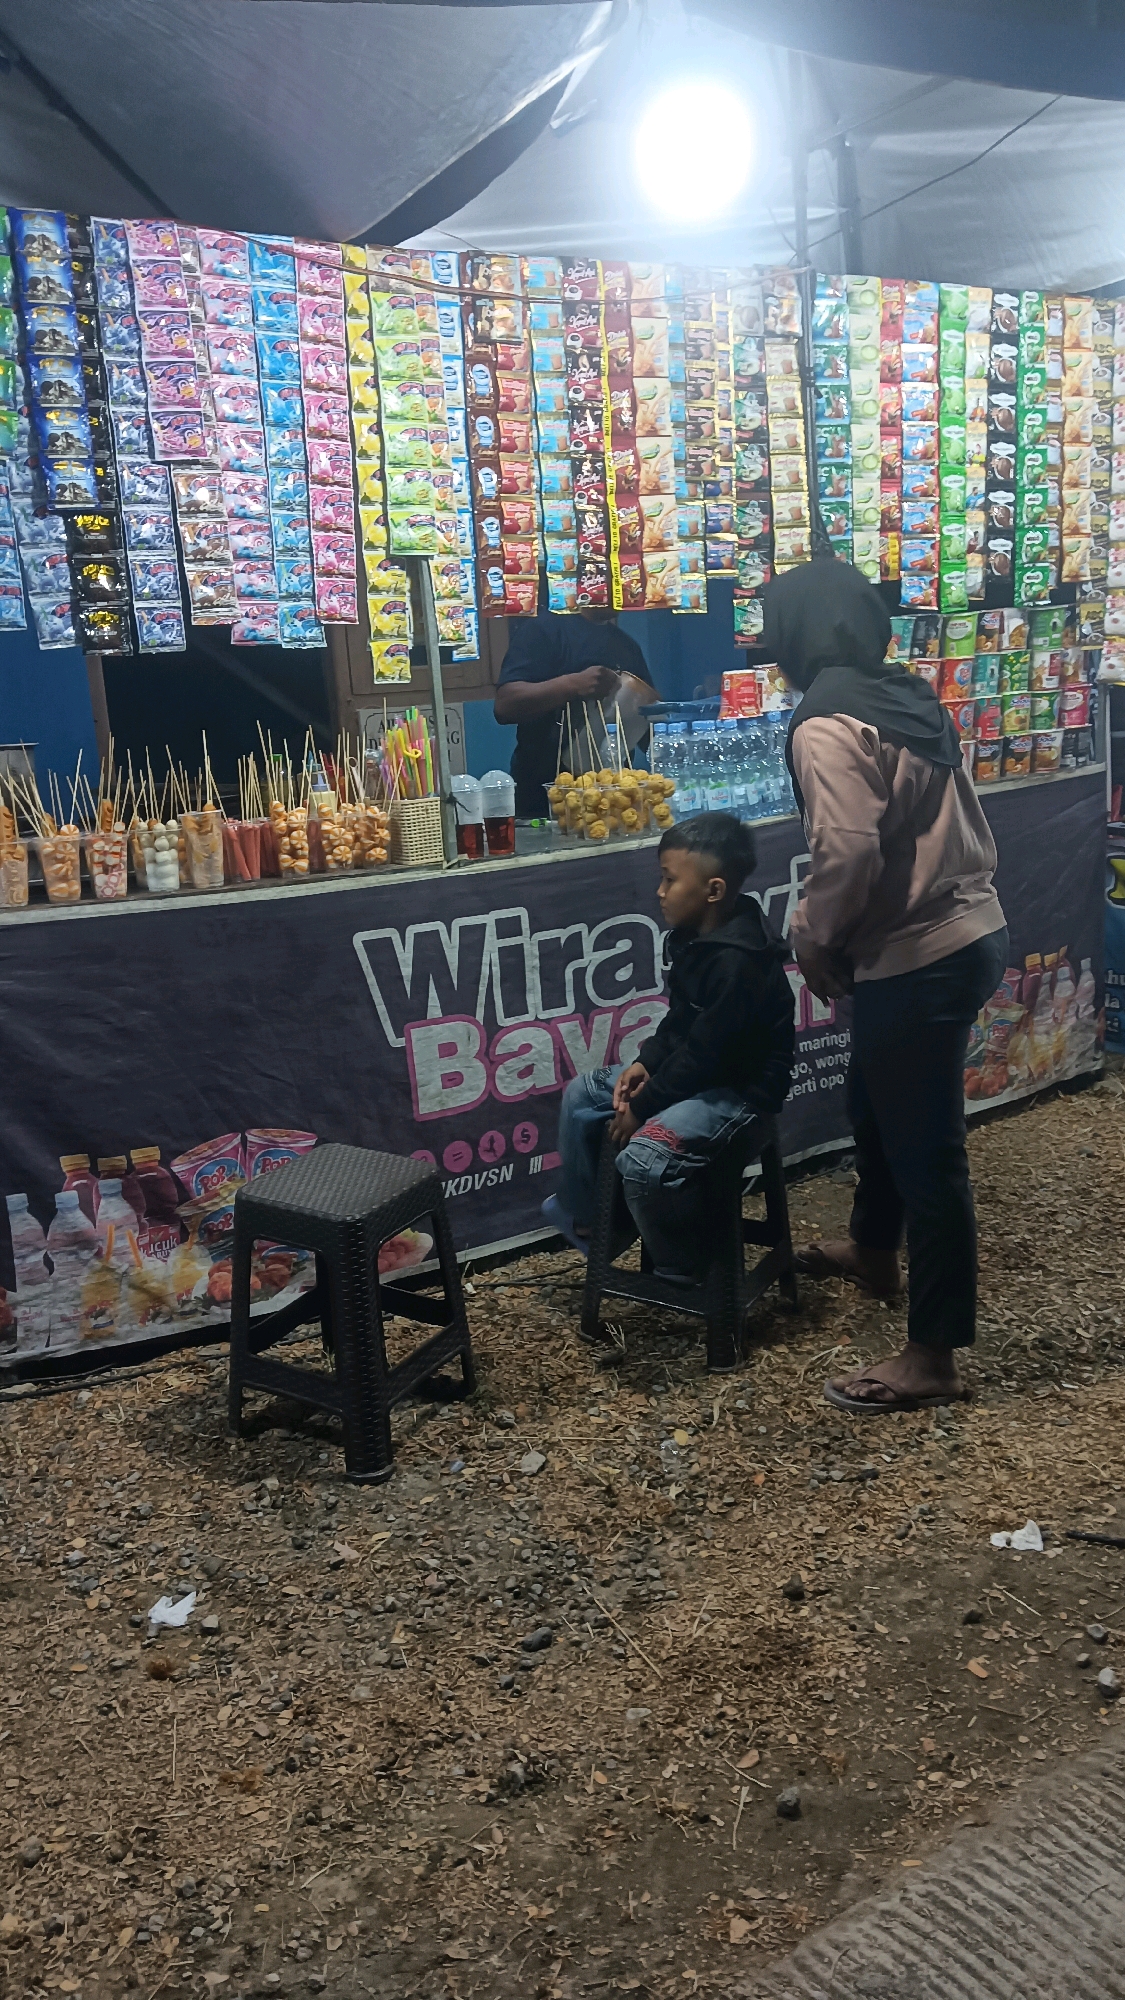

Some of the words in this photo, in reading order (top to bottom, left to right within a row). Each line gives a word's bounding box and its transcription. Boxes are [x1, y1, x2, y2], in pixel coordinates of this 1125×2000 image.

[799, 1028, 851, 1053] maringi
[785, 1076, 817, 1102] gerti
[441, 1163, 514, 1199] KDVSN
